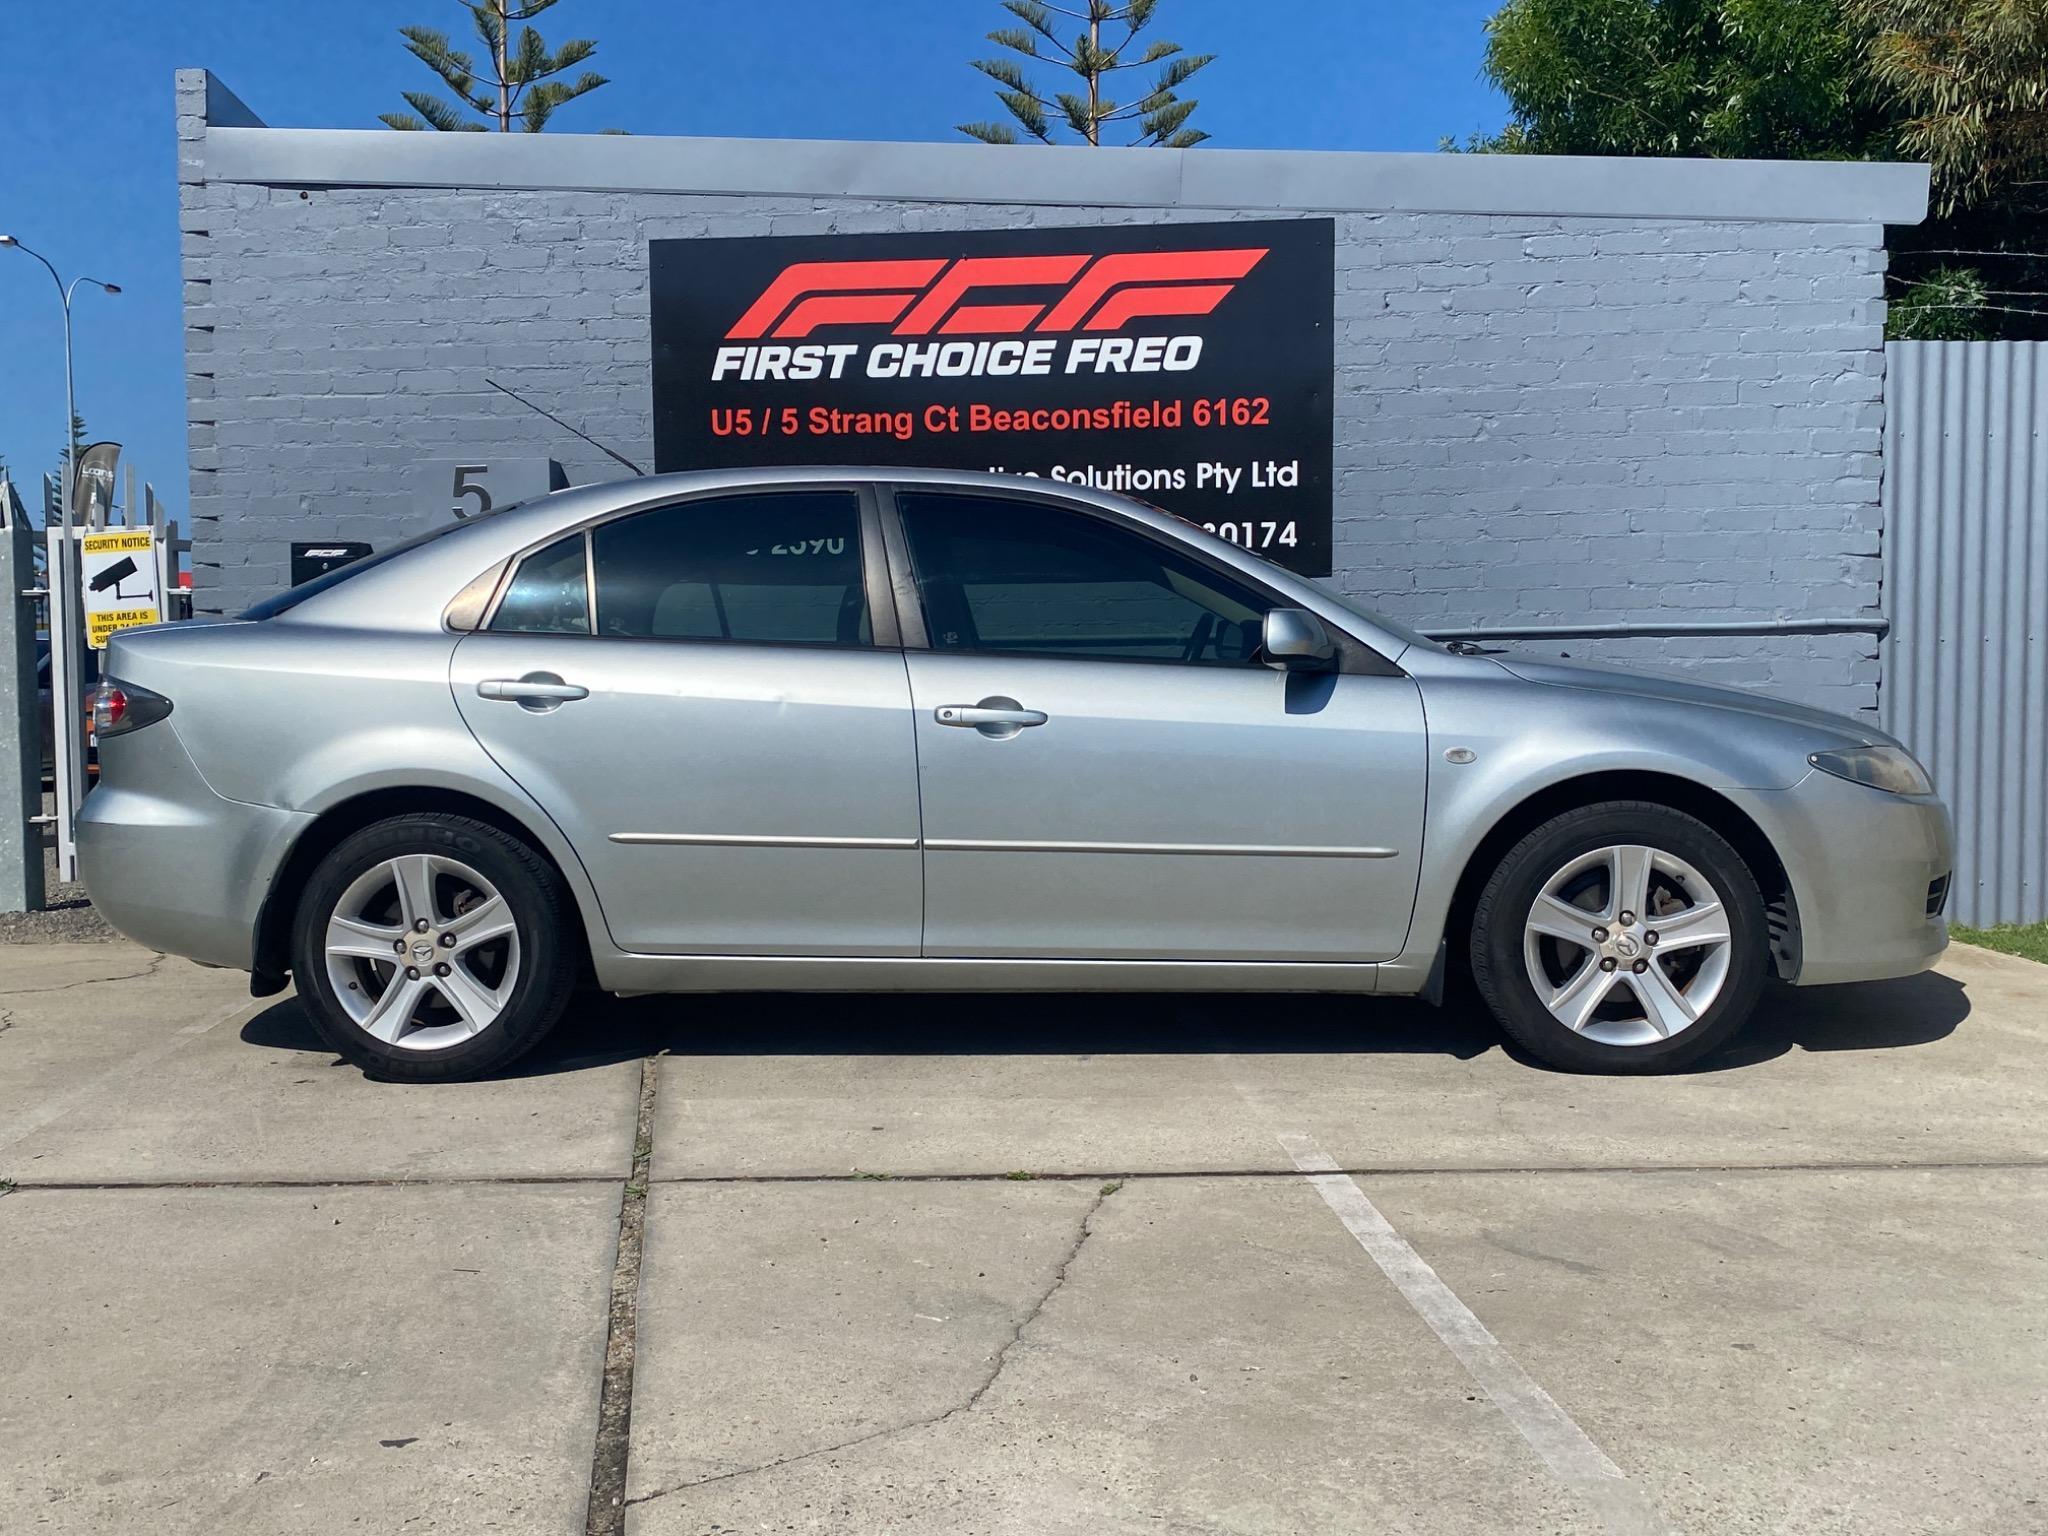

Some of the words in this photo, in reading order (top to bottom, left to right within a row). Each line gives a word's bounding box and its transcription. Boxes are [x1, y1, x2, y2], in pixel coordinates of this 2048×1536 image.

[711, 344, 859, 382] FIRST
[866, 339, 1058, 379] CHOICE
[1064, 335, 1204, 375] FREO
[711, 408, 753, 436] U5
[761, 407, 771, 435] /
[780, 407, 799, 435] 5
[808, 406, 913, 440] Strang
[923, 404, 960, 433] Ct
[969, 400, 1183, 432] Beaconsfield
[1192, 397, 1271, 426] 6162
[451, 464, 492, 520] 5
[1196, 461, 1243, 495] Pty
[1251, 459, 1299, 488] Ltd
[85, 539, 119, 551] SECURITY
[121, 536, 151, 548] NOTICE
[92, 624, 118, 633] UNDER
[97, 613, 114, 622] THIS
[116, 612, 138, 621] AREA
[139, 611, 149, 620] IS
